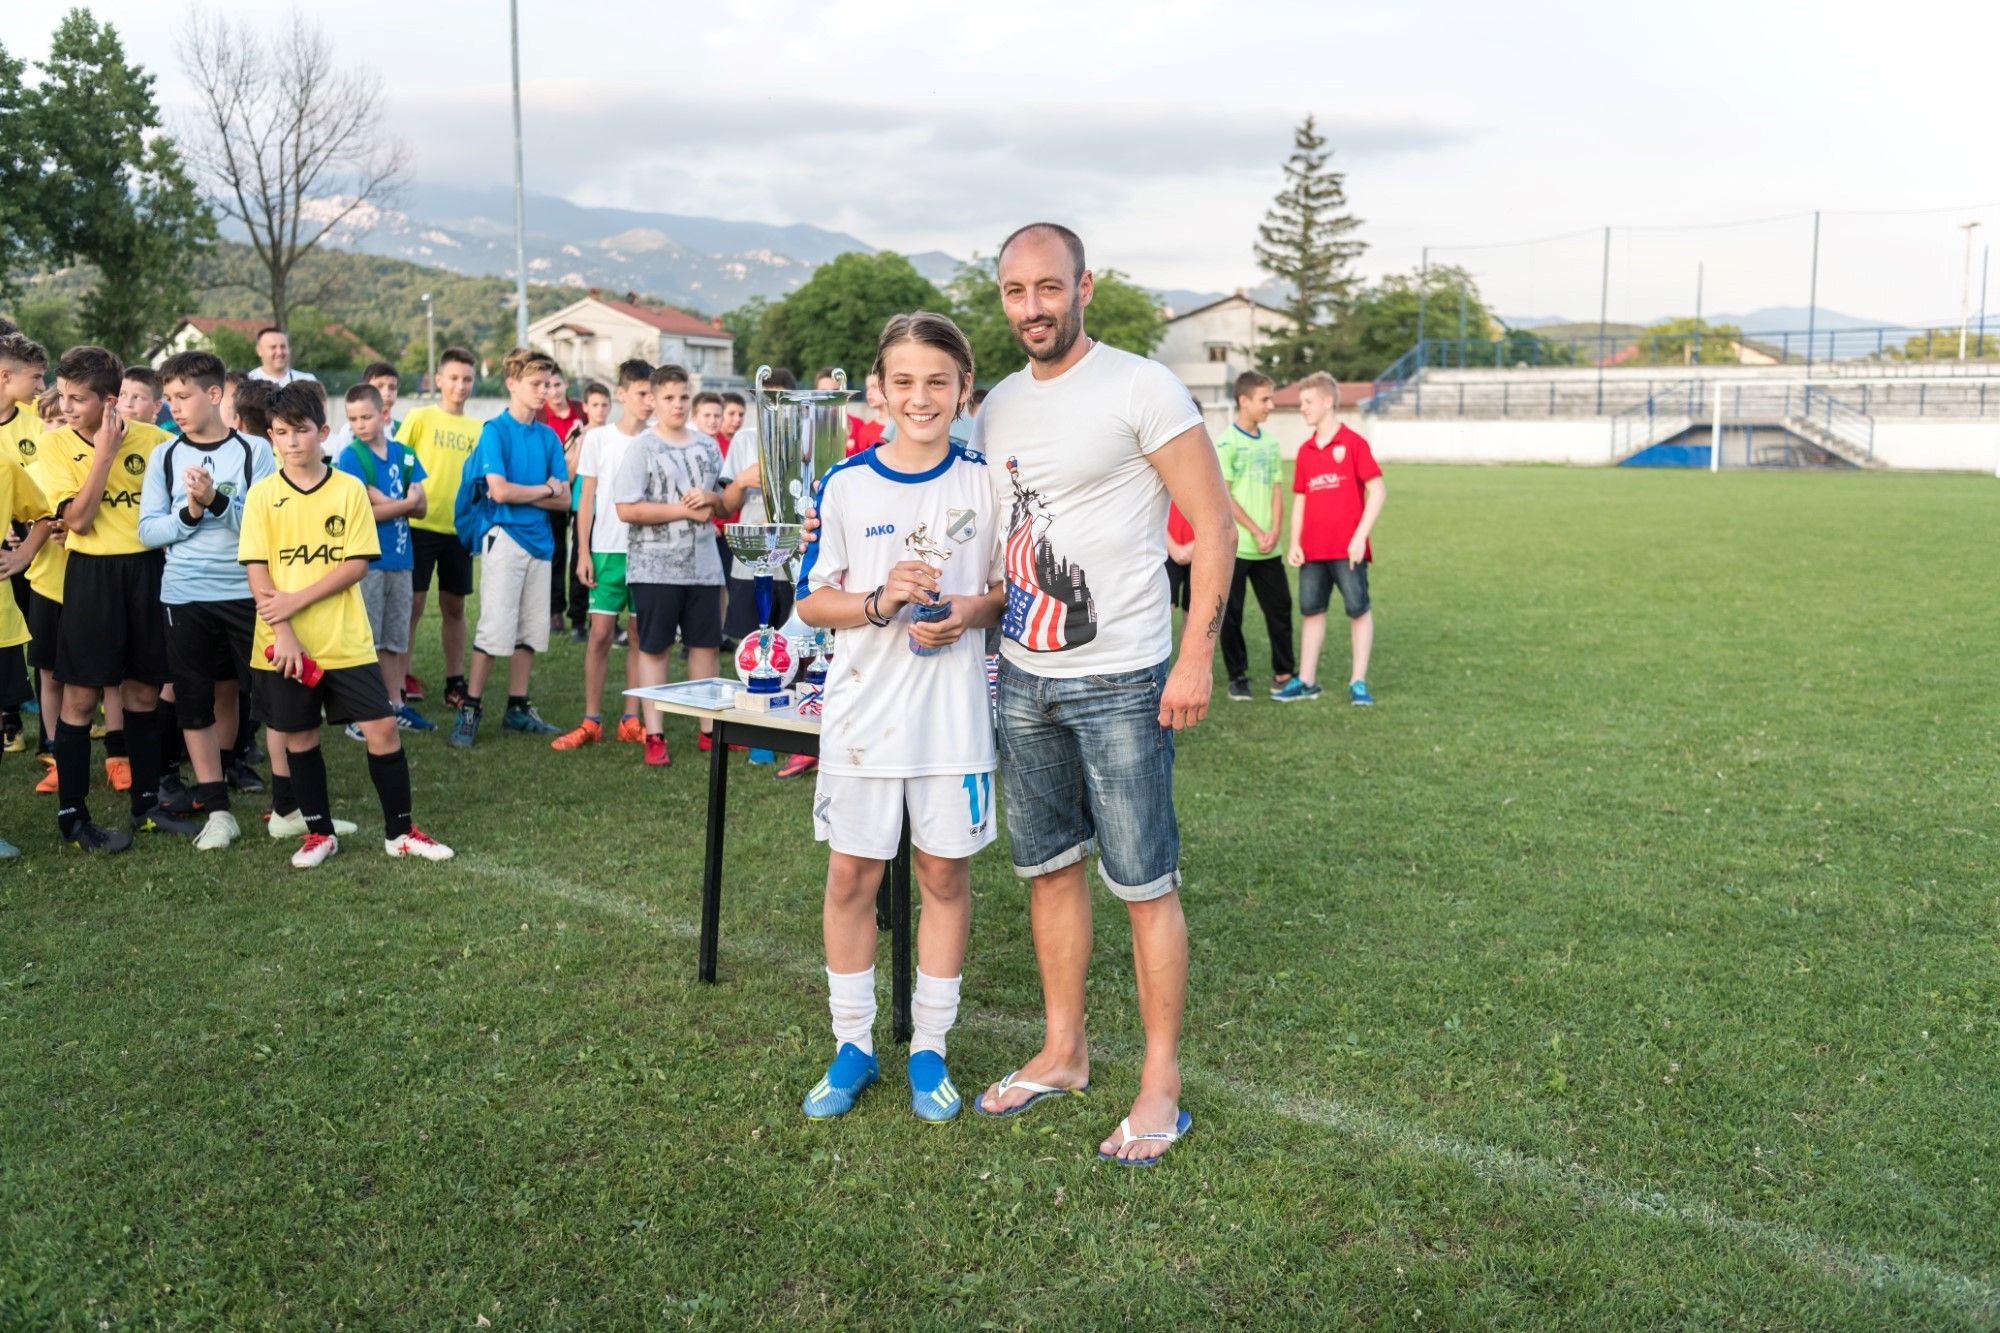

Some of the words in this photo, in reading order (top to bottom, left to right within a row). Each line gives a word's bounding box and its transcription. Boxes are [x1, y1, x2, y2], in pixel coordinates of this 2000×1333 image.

[102, 490, 141, 508] AAC
[865, 524, 895, 538] JAKO
[279, 544, 344, 567] FAAC
[962, 773, 990, 825] 11
